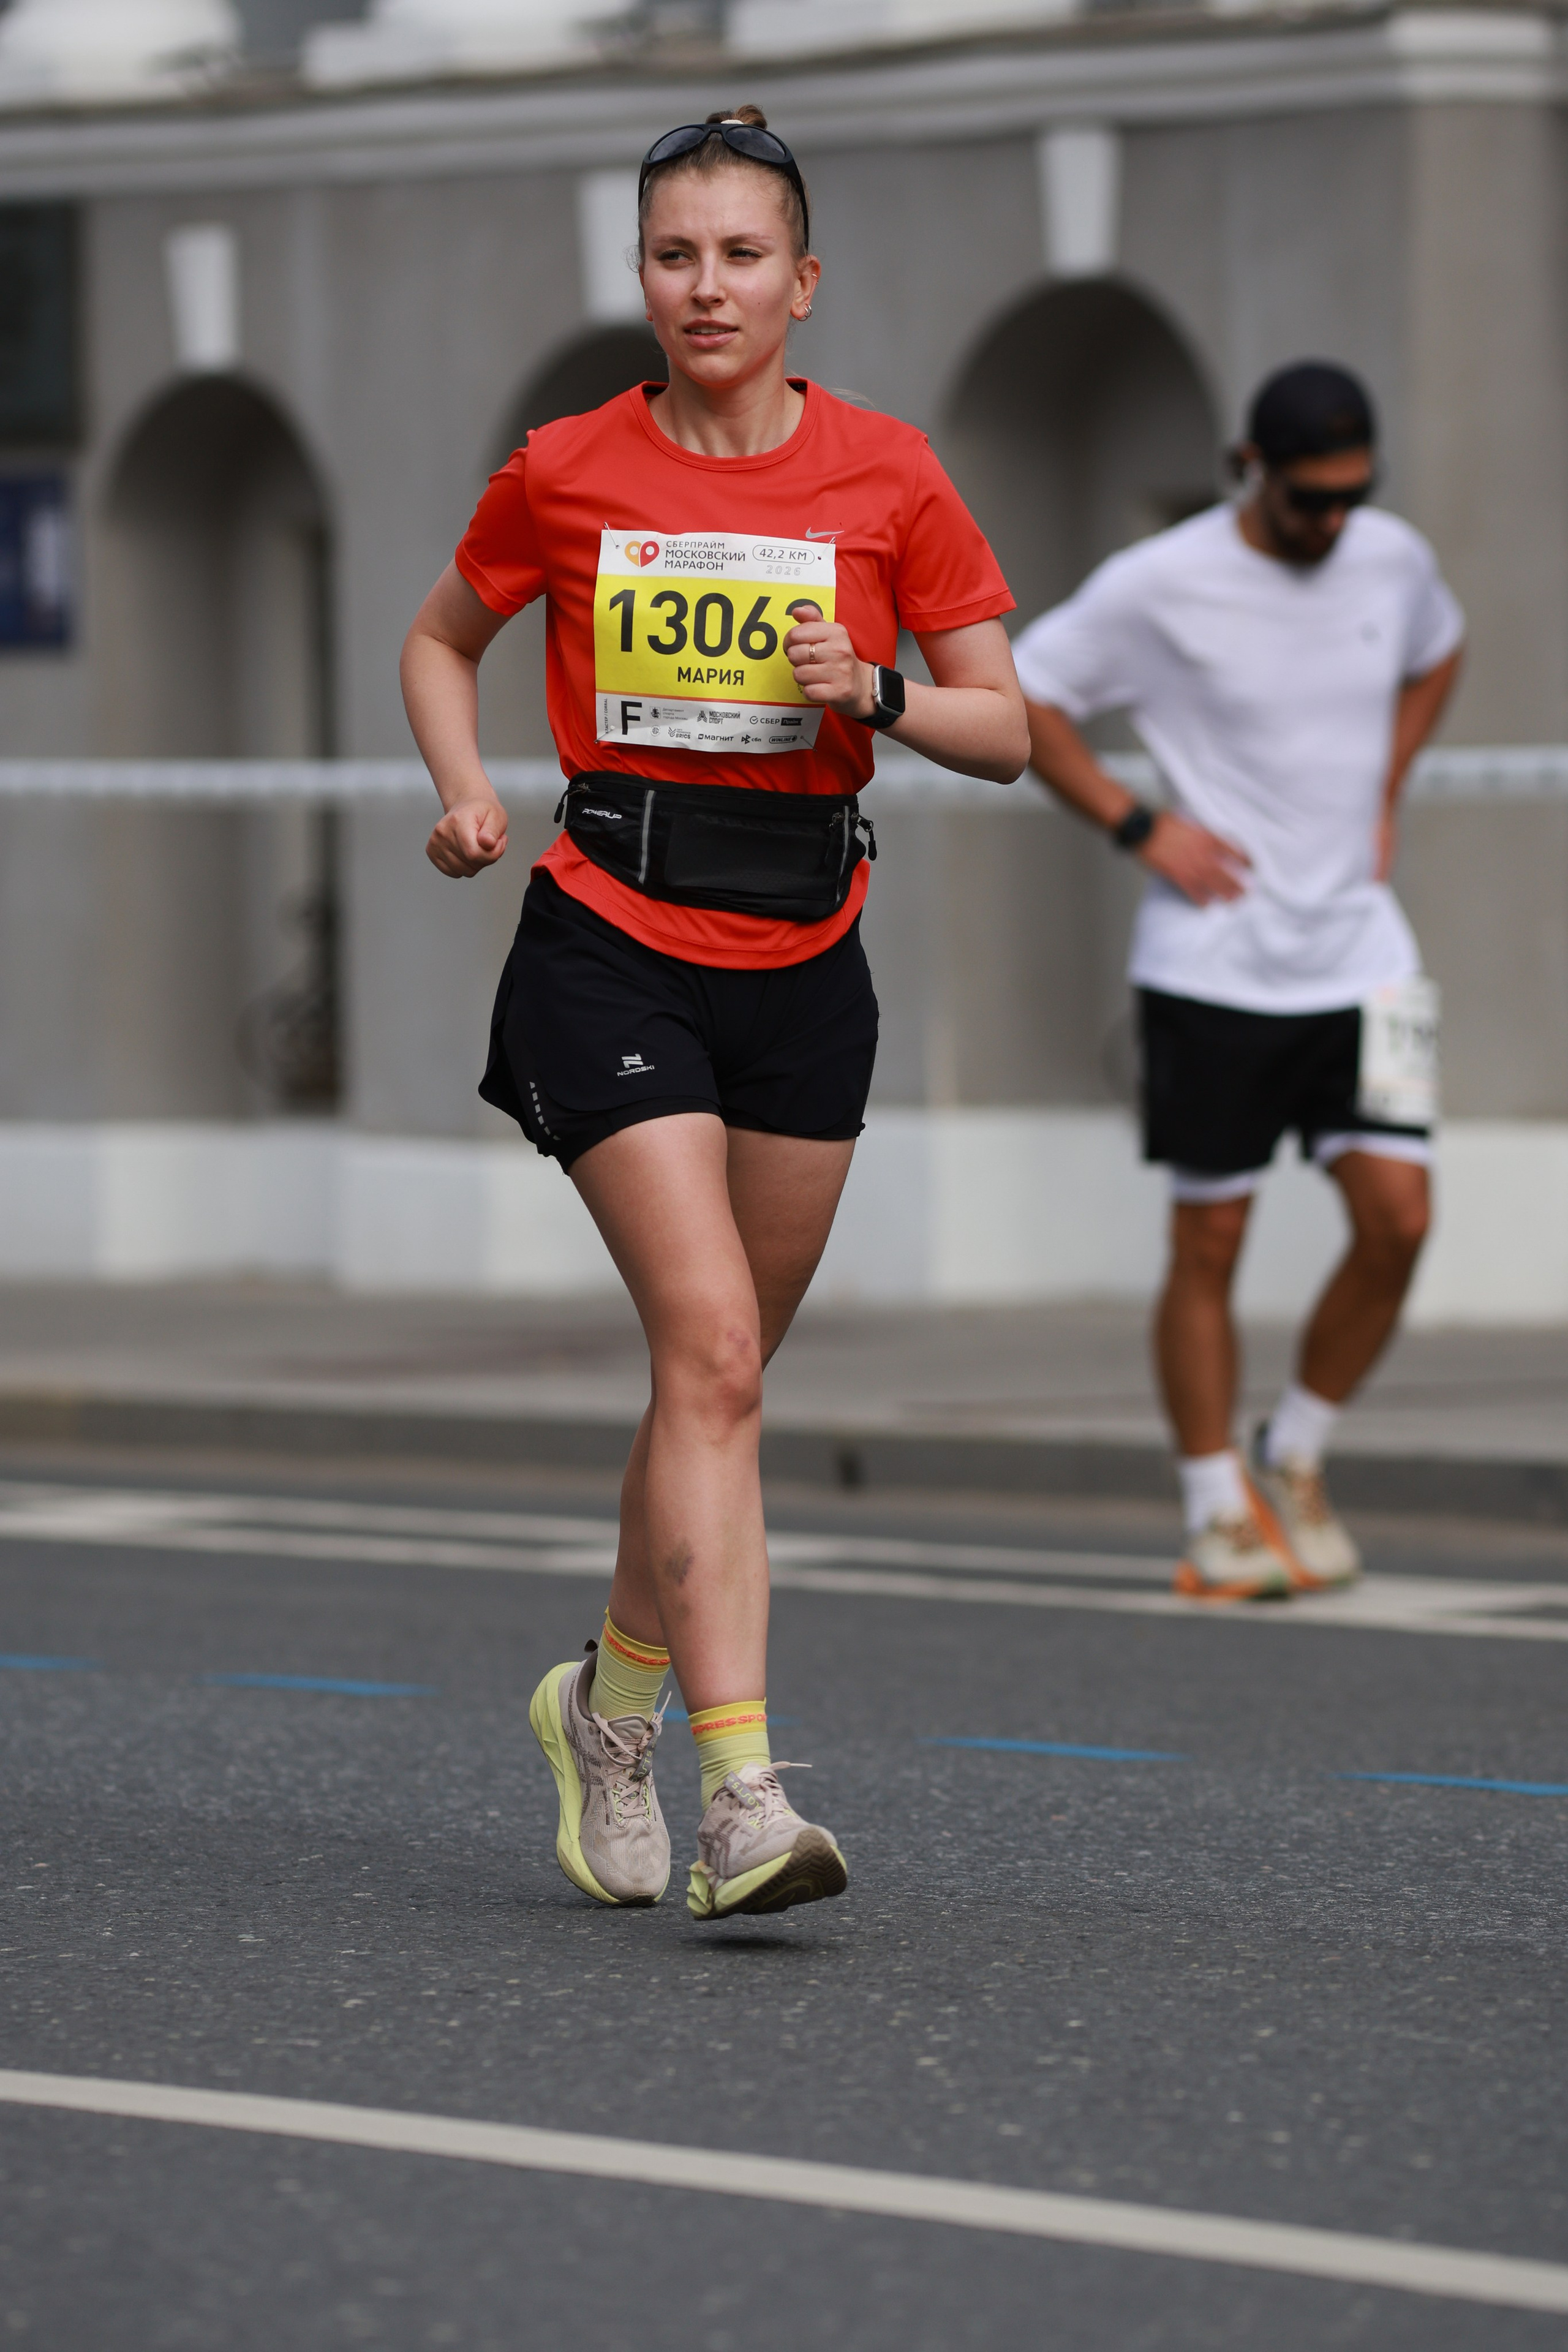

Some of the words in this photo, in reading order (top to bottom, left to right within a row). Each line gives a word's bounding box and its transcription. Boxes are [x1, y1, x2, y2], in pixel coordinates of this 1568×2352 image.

[666, 540, 725, 549] СБЕРПРАЙМ
[665, 549, 746, 562] МОСКОВСКИЙ
[760, 548, 785, 560] 42,2
[789, 551, 807, 560] КМ
[665, 560, 724, 571] МАРАФОН
[766, 565, 801, 576] 2026
[677, 666, 745, 686] МАРИЯ
[620, 701, 643, 735] F
[617, 1065, 655, 1077] NORDSKI
